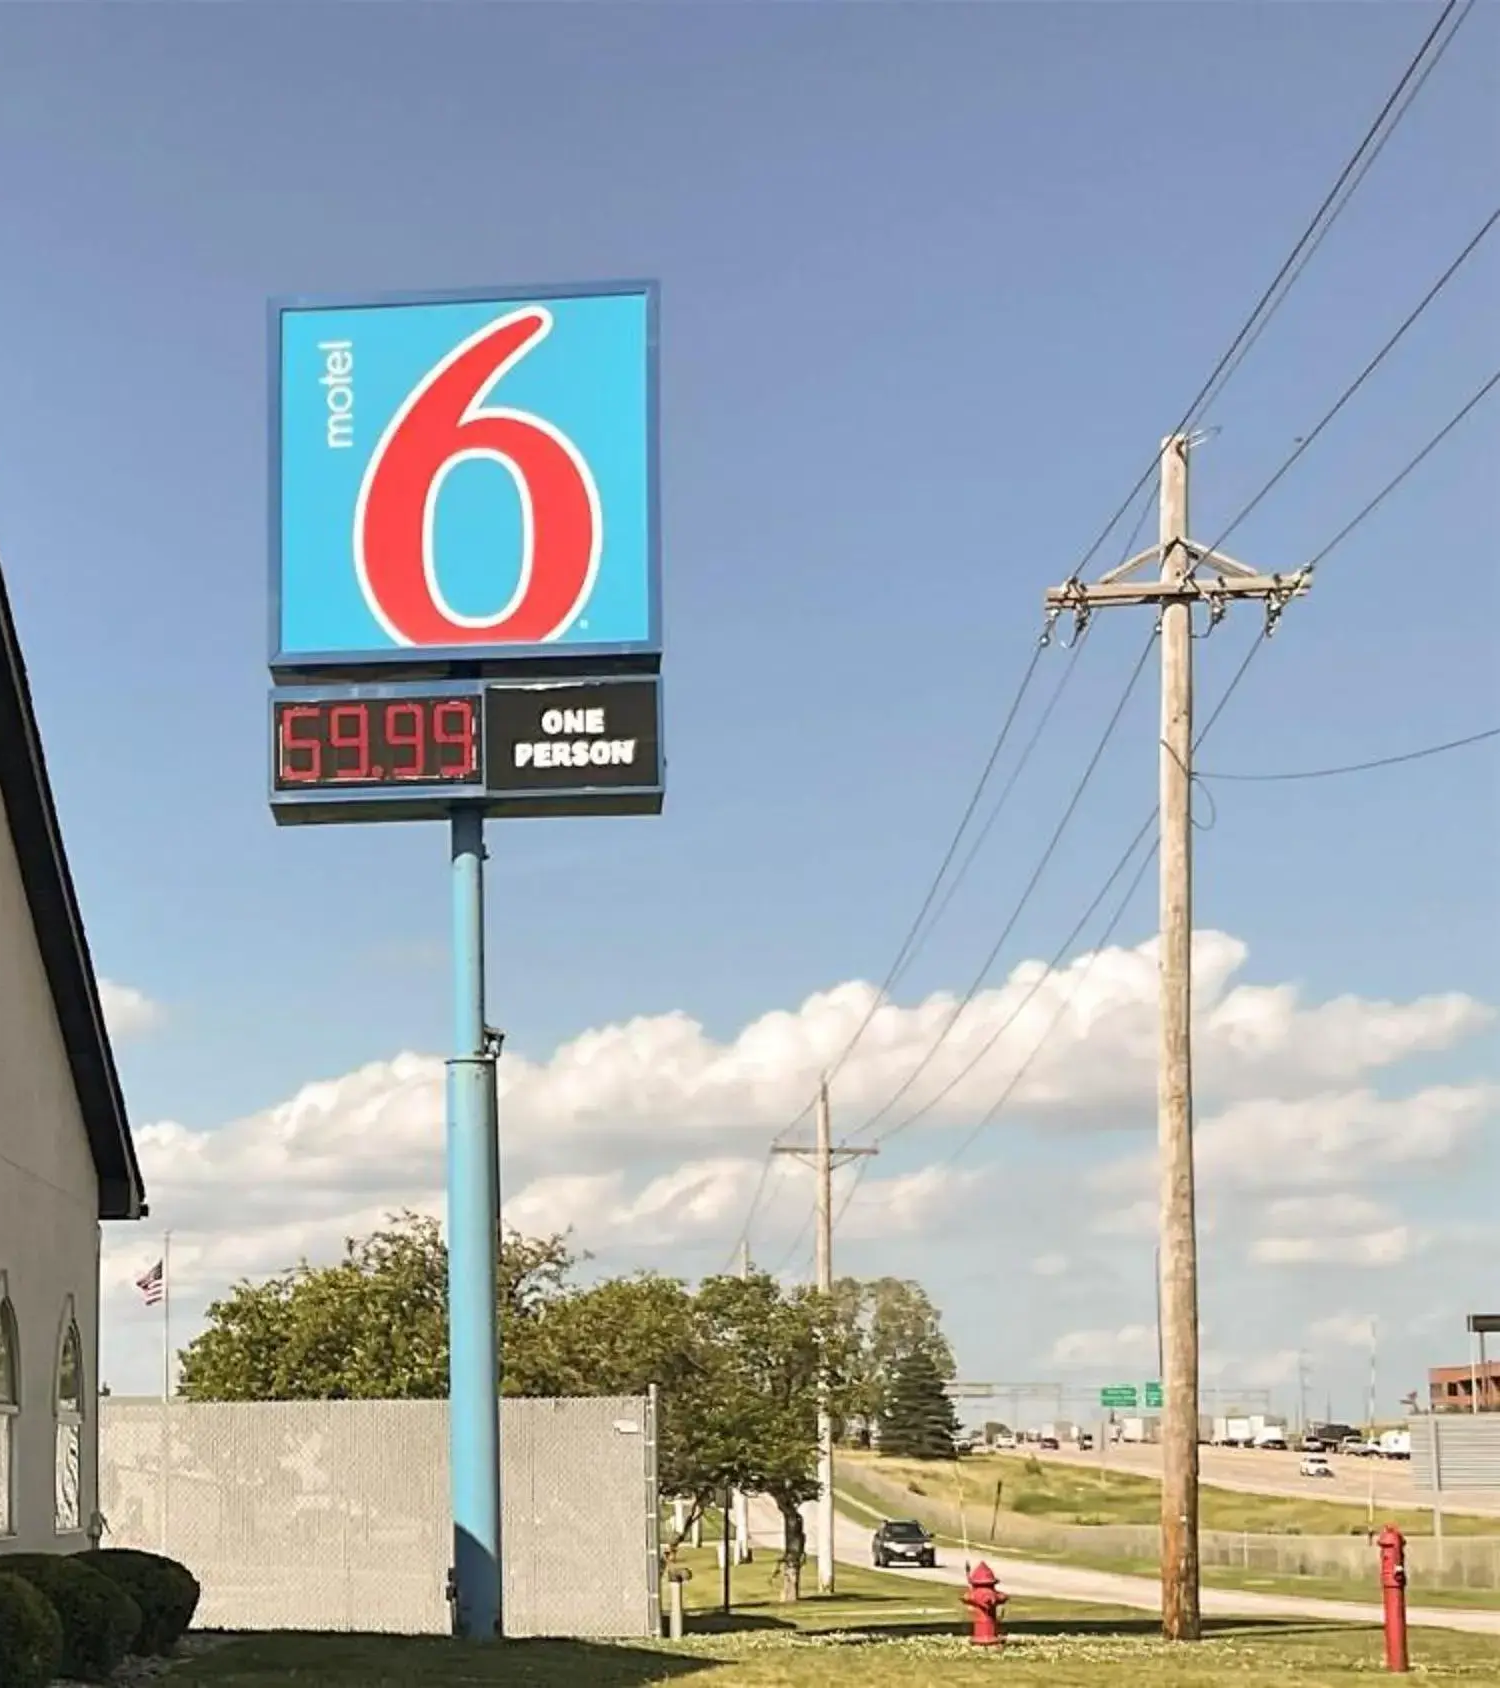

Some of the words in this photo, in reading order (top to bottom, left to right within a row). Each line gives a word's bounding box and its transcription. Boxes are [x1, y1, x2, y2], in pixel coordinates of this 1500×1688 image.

[316, 340, 353, 448] motel
[352, 304, 603, 647] 6
[280, 699, 473, 782] 59.99
[514, 738, 637, 768] PERSON
[541, 707, 605, 736] ONE
